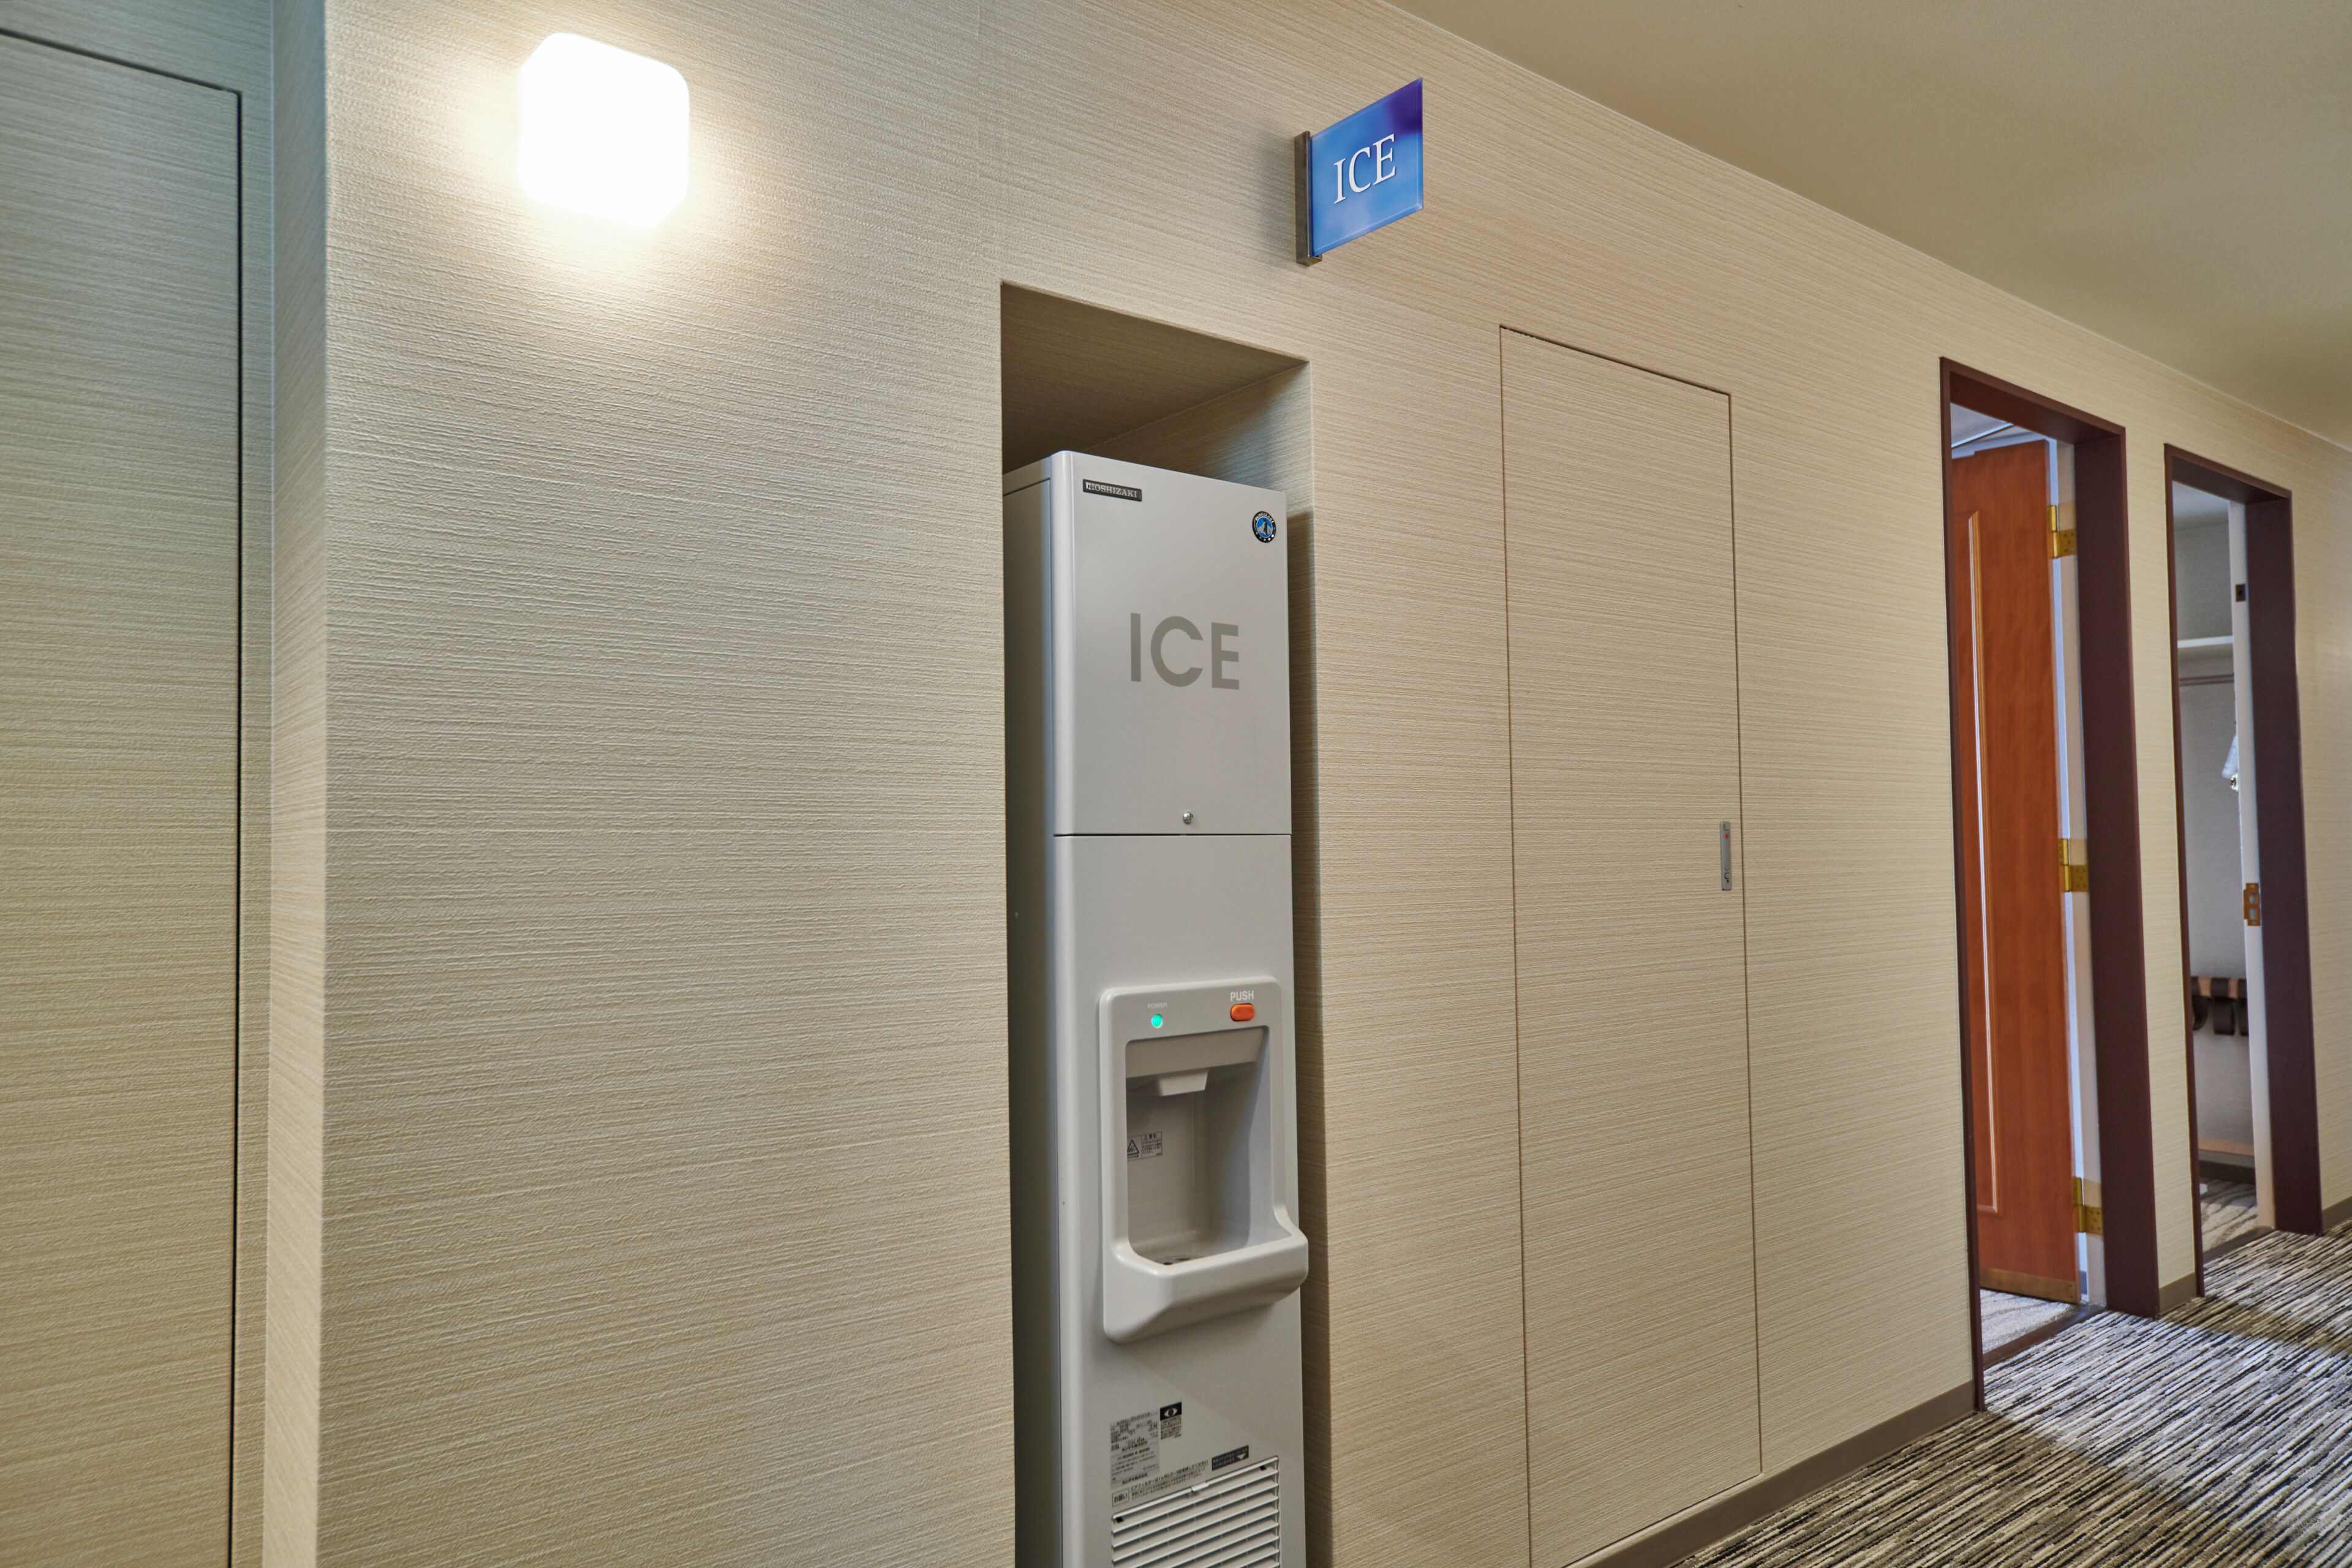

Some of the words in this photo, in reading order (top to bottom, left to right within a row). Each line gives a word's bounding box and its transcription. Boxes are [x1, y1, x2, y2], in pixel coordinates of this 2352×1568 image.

[1333, 133, 1396, 205] ICE
[1085, 481, 1138, 499] HOSHIZAKI
[1130, 612, 1240, 690] ICE
[1229, 990, 1254, 1002] PUSH
[1147, 1001, 1168, 1010] POWER
